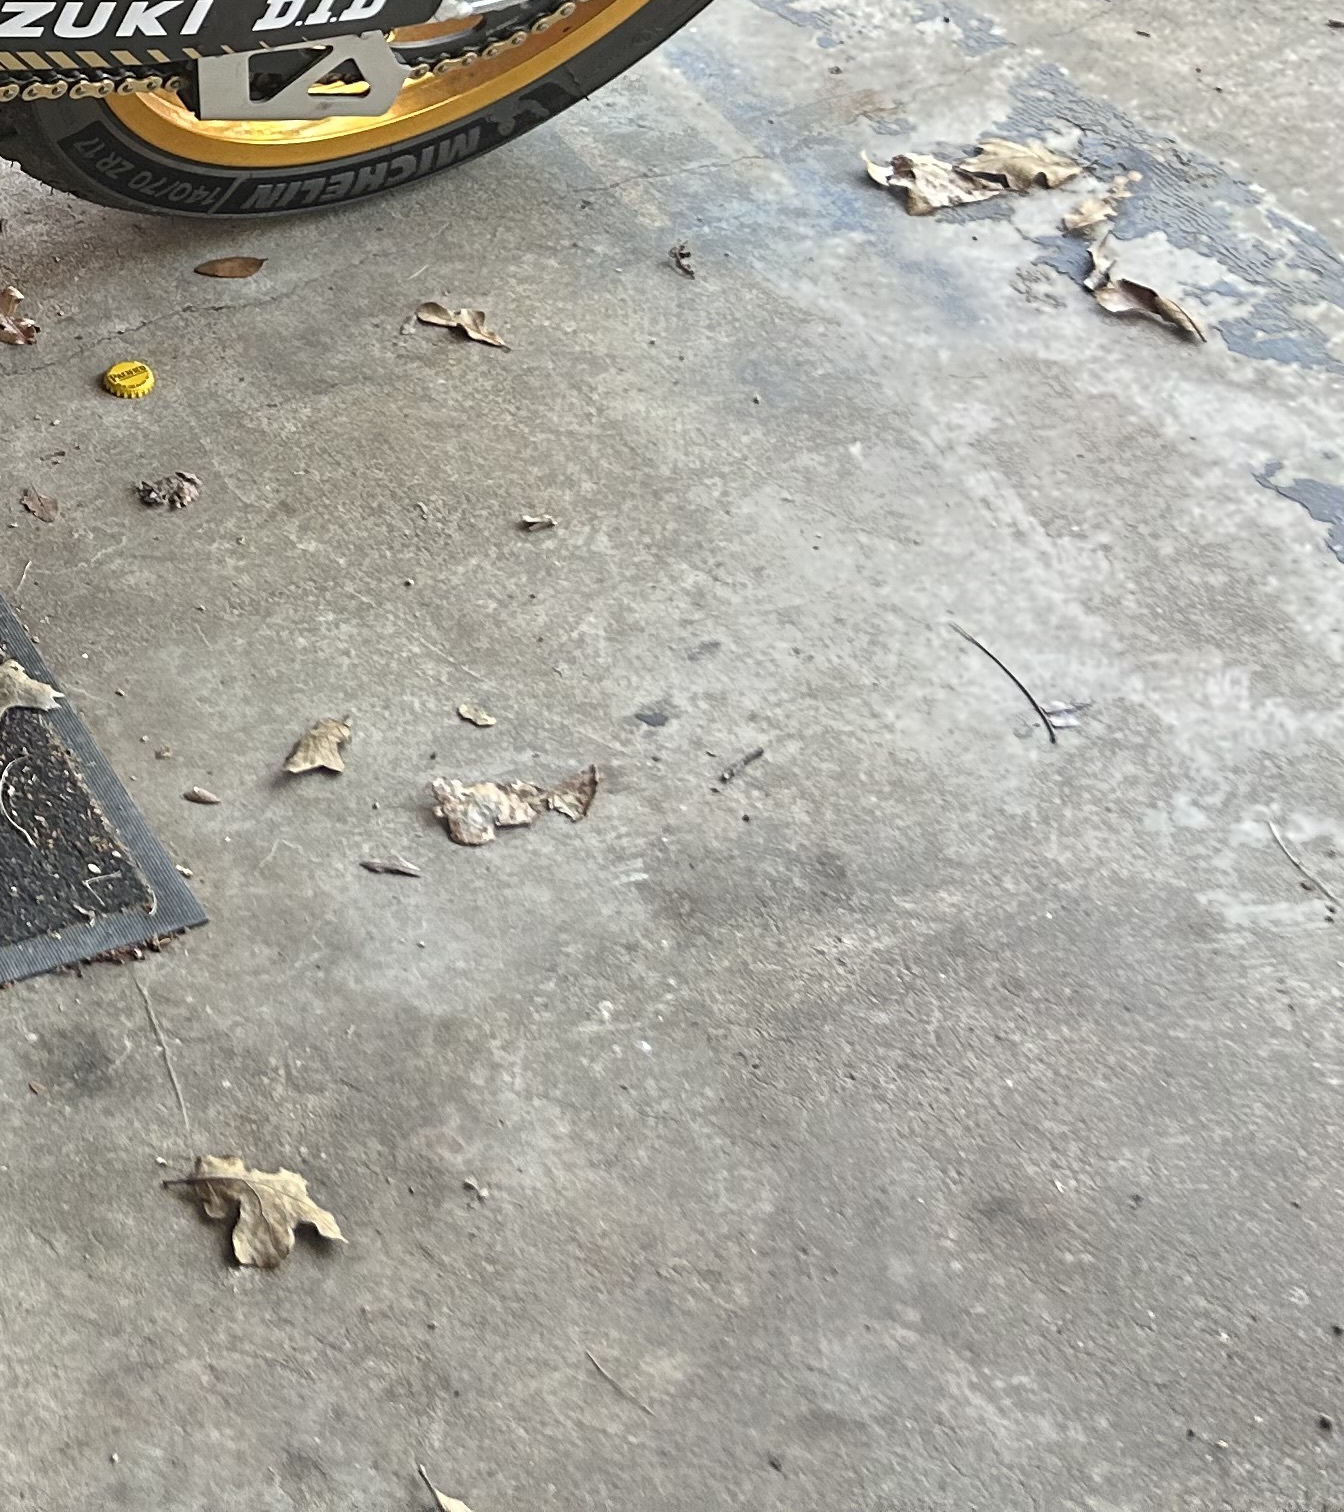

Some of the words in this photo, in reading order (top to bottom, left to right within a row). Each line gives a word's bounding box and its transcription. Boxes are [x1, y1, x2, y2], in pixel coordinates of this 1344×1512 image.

[72, 134, 101, 156] 17
[95, 151, 131, 181] ZR
[240, 125, 482, 212] MICHELIN
[129, 169, 223, 208] 140/70
